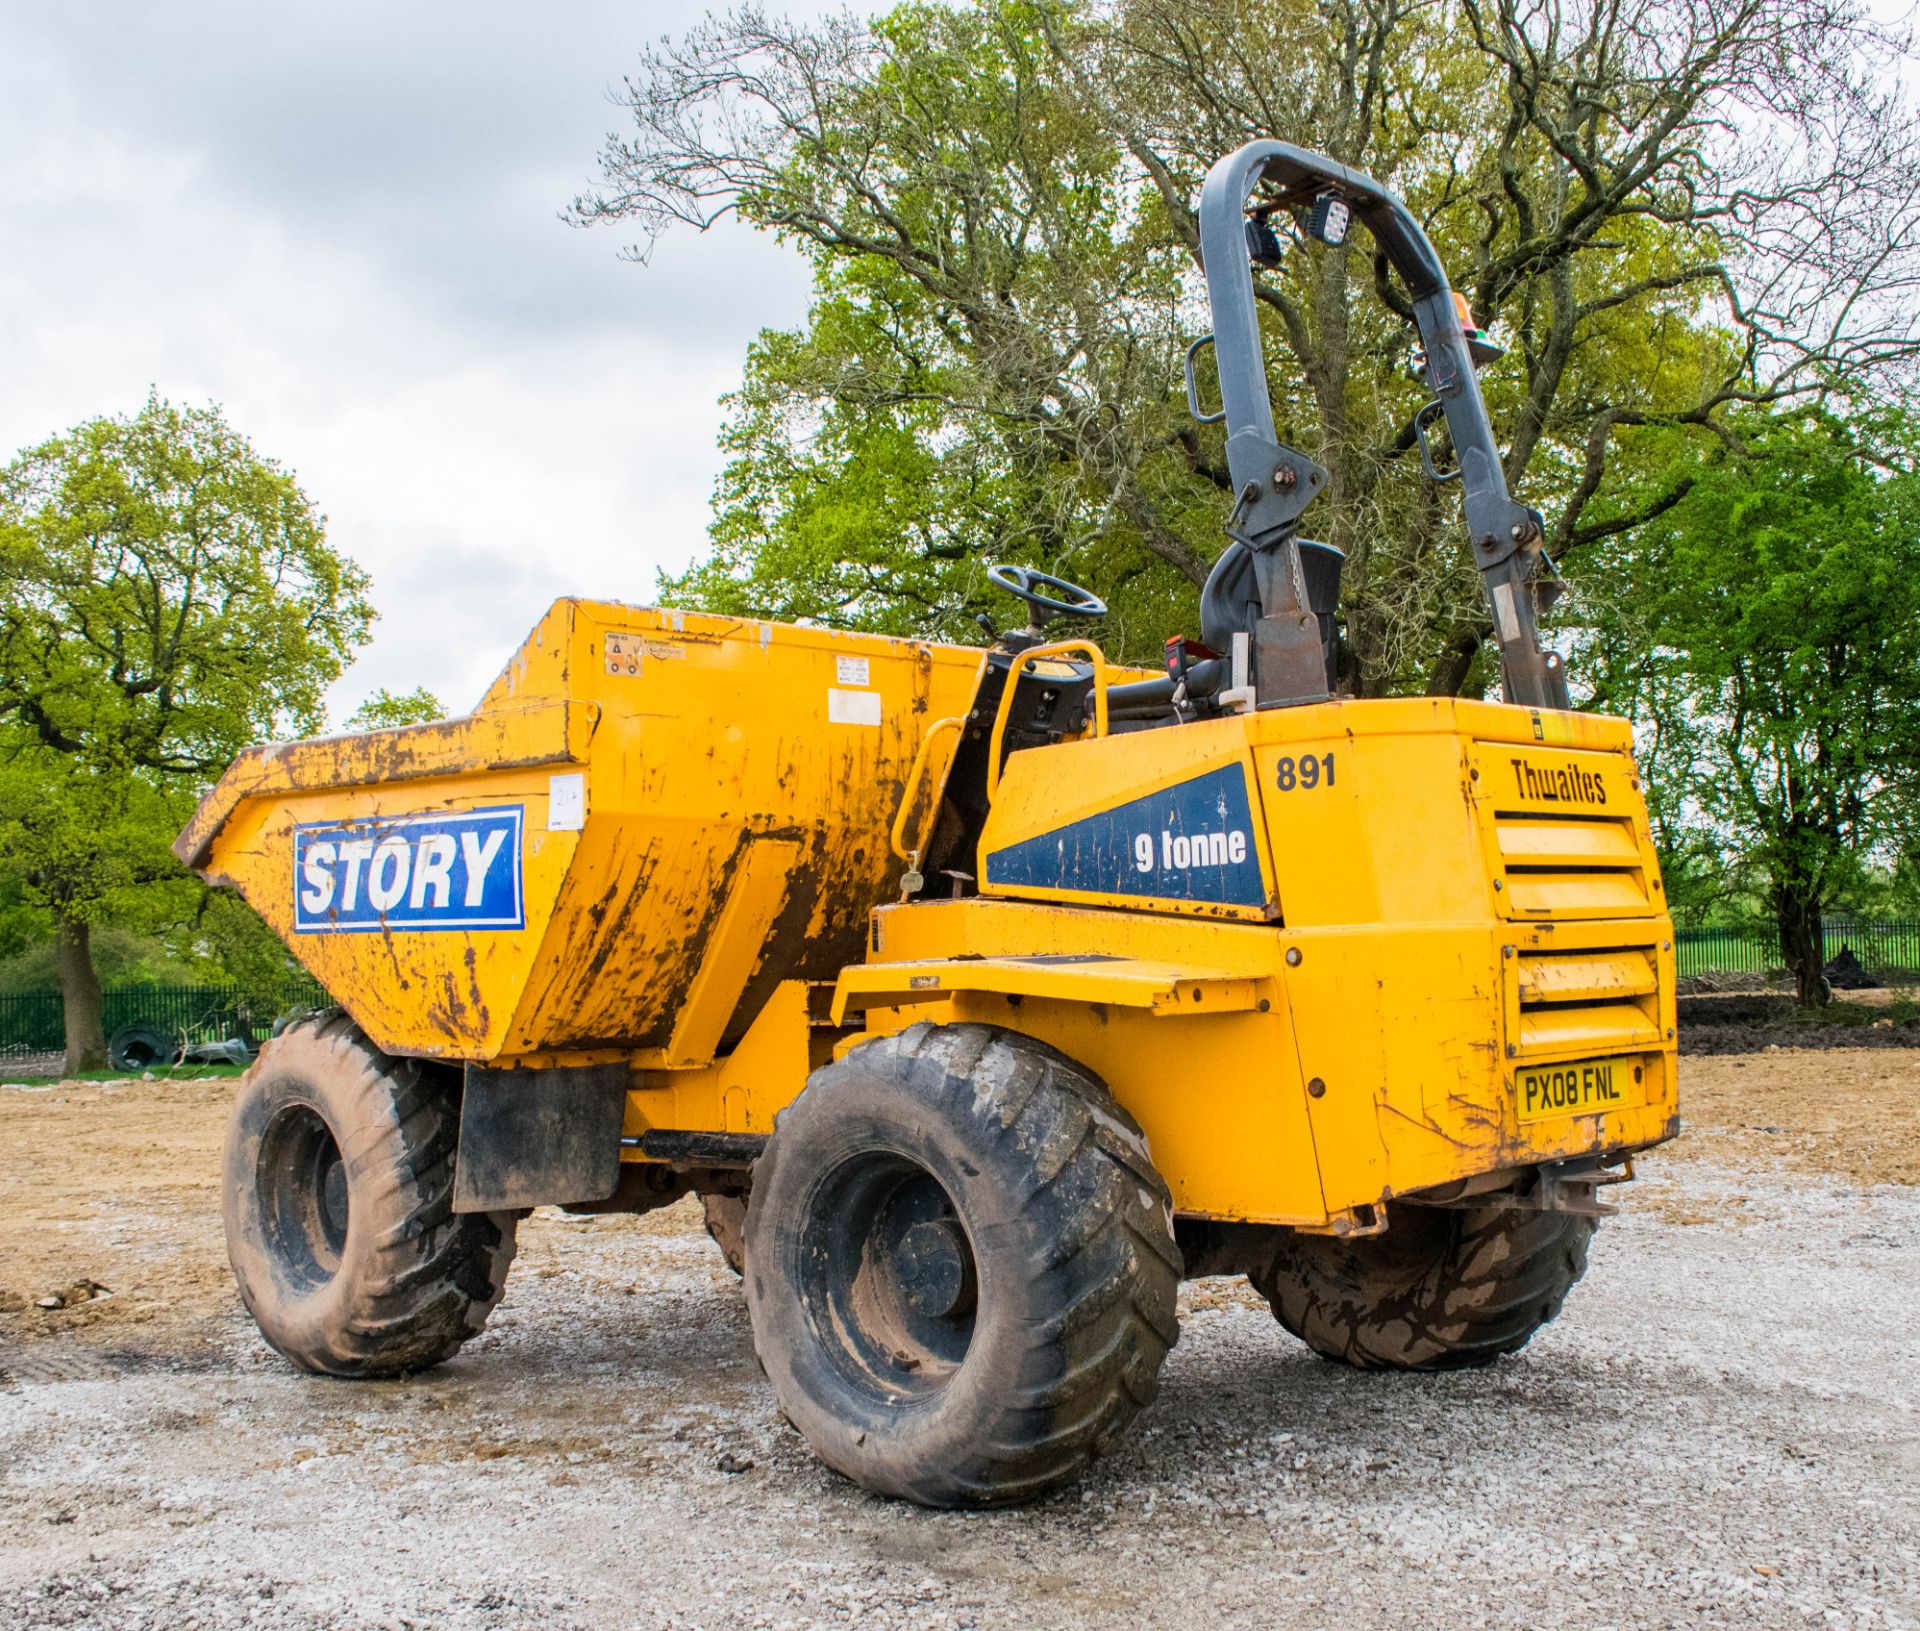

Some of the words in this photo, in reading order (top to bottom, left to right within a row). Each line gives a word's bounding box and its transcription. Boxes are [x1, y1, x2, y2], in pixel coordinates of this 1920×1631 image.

[1277, 753, 1335, 791] 891
[1510, 759, 1606, 804] Thwaites
[301, 829, 509, 914] STORY
[1135, 833, 1154, 873] 9
[1161, 830, 1246, 870] tonne
[1525, 1070, 1578, 1112] PX08
[1582, 1065, 1620, 1103] FNL
